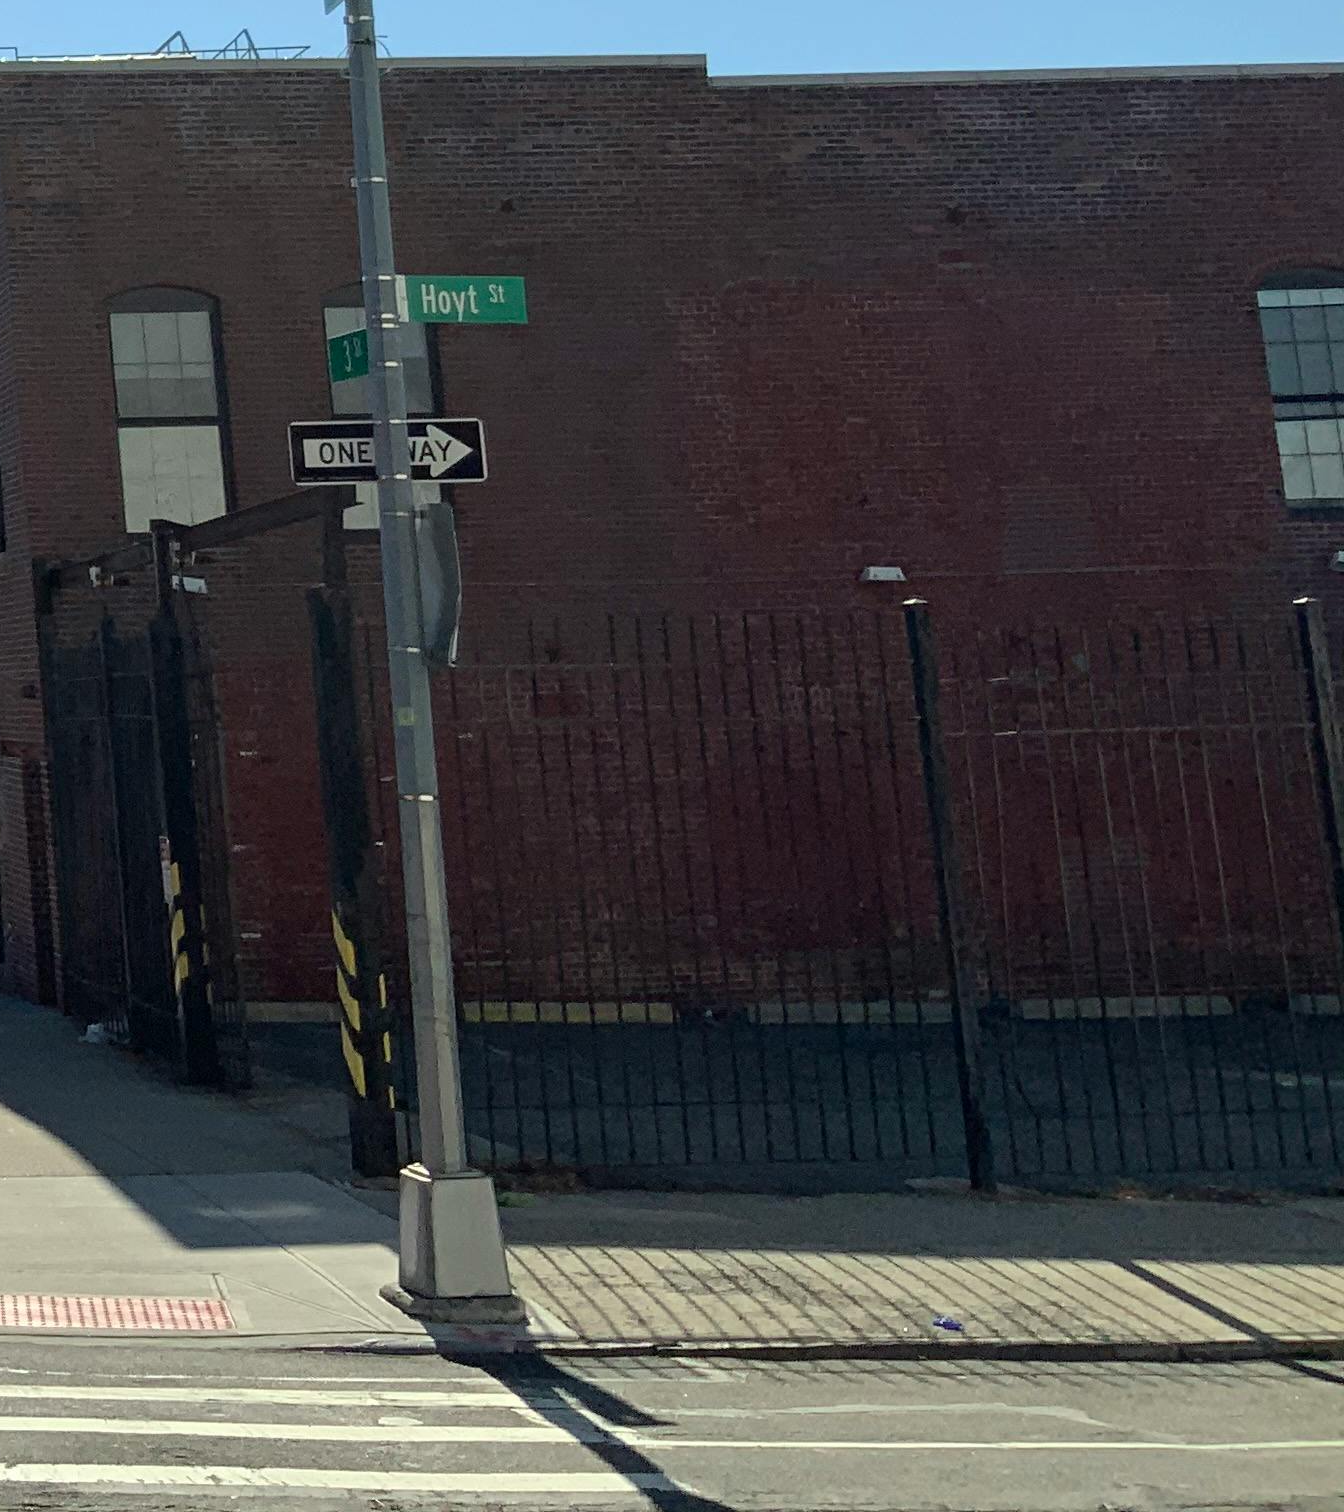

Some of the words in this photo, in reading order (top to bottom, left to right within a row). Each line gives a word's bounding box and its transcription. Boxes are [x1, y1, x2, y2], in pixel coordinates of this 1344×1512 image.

[421, 284, 479, 322] Hoyt
[488, 284, 505, 304] St
[343, 340, 352, 373] 3
[319, 441, 372, 464] ONE
[408, 439, 452, 465] AY
